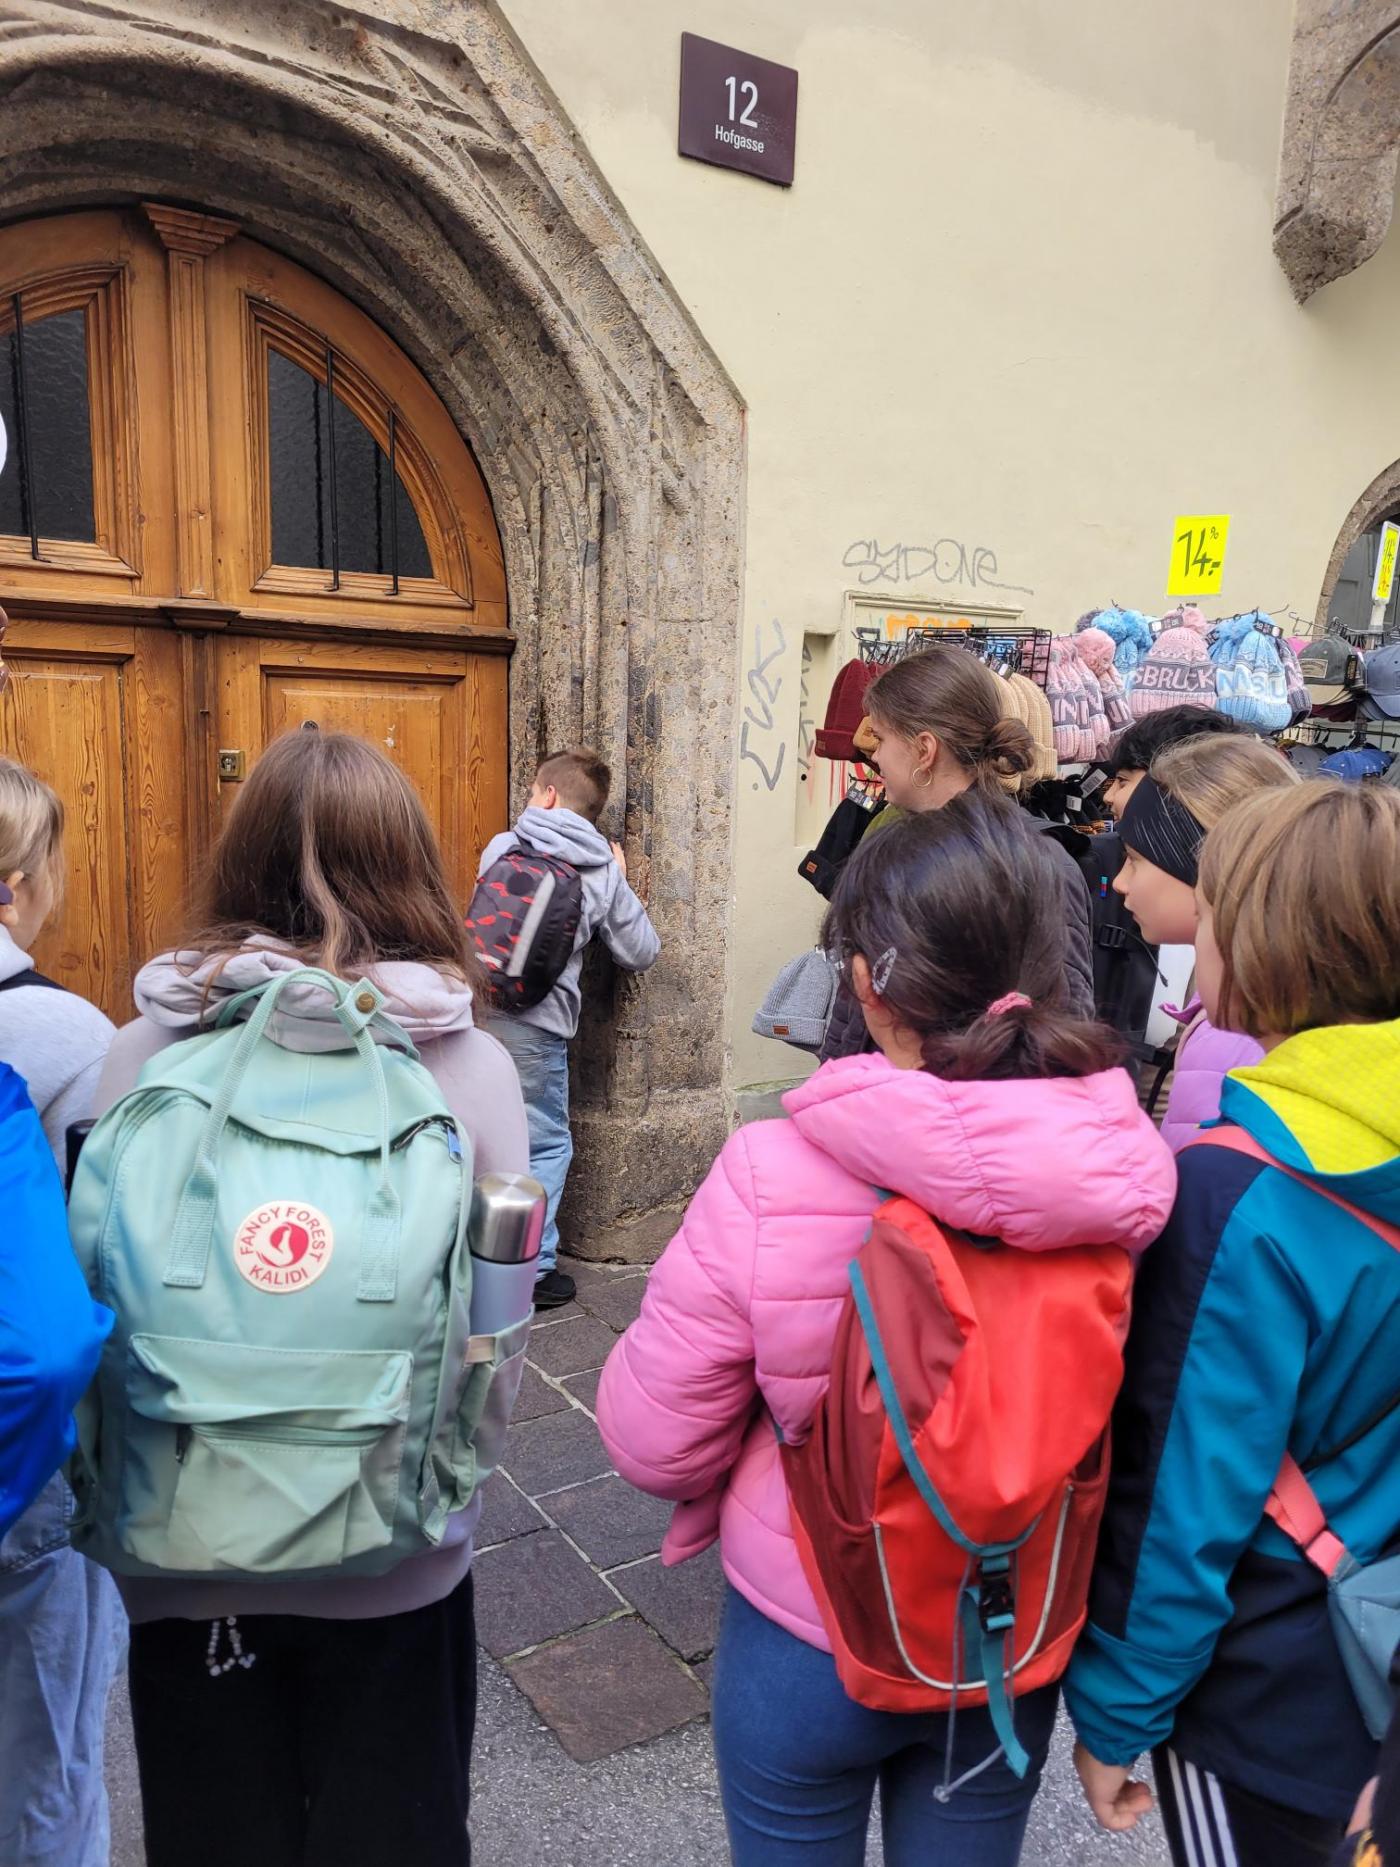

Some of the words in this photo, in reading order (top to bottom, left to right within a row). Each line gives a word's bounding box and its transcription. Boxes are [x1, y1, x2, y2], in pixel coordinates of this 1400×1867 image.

[725, 76, 758, 128] 12
[715, 124, 764, 153] Hofgasse
[240, 1207, 280, 1255] FANCY
[286, 1207, 325, 1262] FOREST
[249, 1264, 308, 1285] KALIDI
